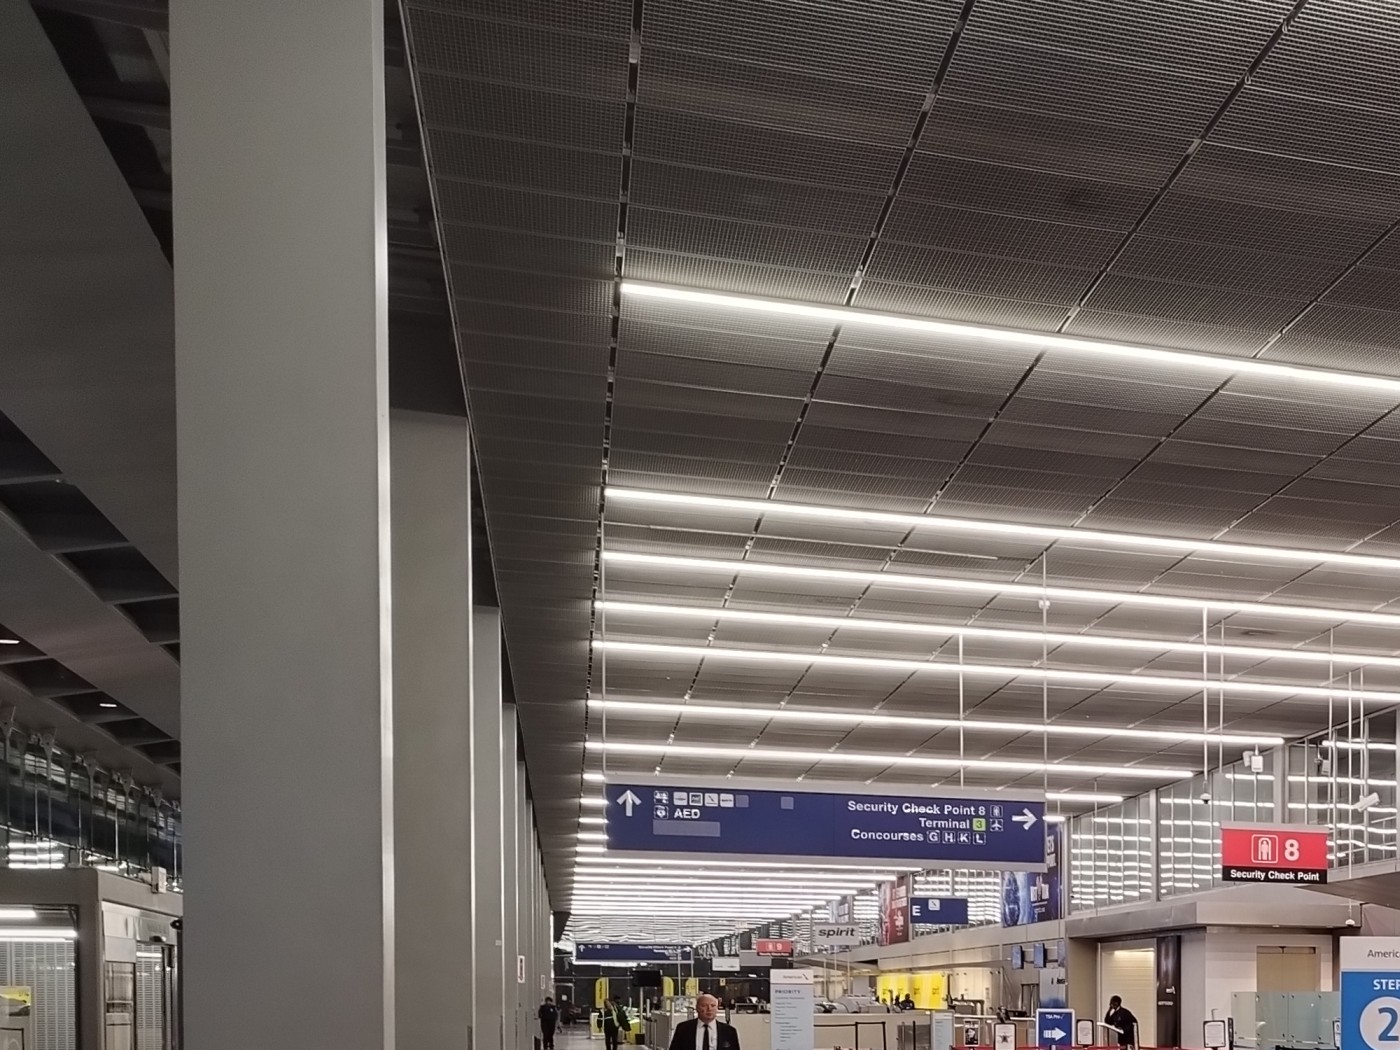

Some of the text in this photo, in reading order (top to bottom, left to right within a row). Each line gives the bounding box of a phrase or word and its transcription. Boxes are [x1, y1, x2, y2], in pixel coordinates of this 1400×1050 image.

[674, 808, 700, 819] AED
[848, 801, 986, 816] Security Check Point 8
[919, 817, 983, 829] Terminal 3
[851, 829, 983, 843] Concourses G H K L
[1284, 839, 1300, 861] 8
[1230, 869, 1320, 881] Security Check Point
[912, 905, 921, 916] E
[818, 926, 856, 938] spirit
[1378, 1007, 1399, 1042] 2
